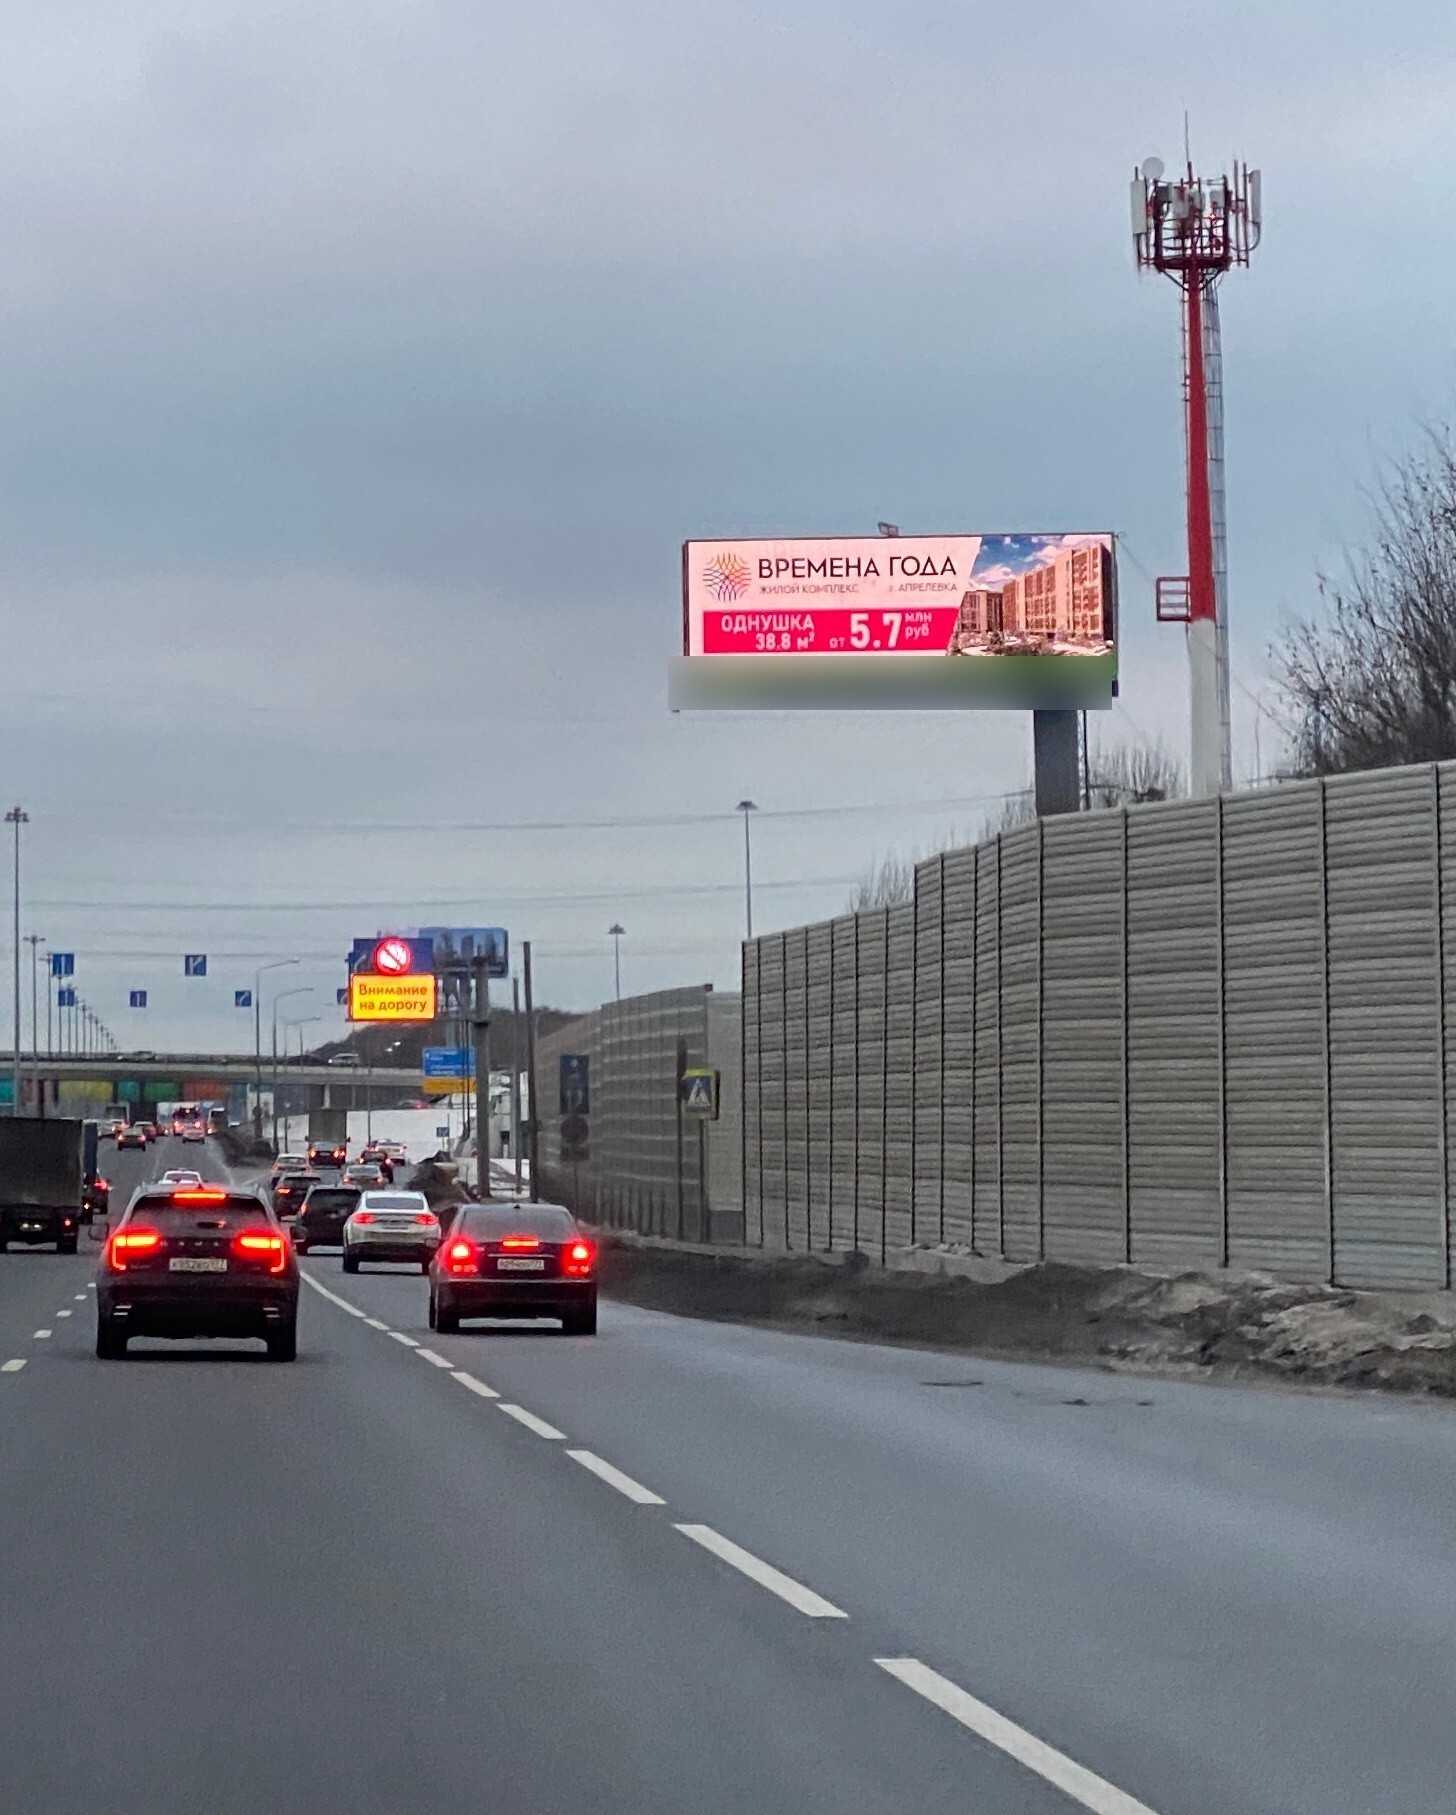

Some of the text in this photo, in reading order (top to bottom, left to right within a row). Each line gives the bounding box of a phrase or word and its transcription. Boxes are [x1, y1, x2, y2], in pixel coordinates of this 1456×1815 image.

[758, 555, 957, 579] ВРЕМЕНА ГОДА
[760, 583, 859, 594] ЖИЛОЙ КОМПЛЕКС
[898, 582, 958, 593] АПРЕЛЕВКА
[721, 614, 815, 634] ОДНУШКА
[829, 612, 902, 649] от 5.7
[905, 622, 929, 640] руб
[755, 632, 791, 650] 38.8
[359, 984, 428, 996] Внимание
[359, 1001, 427, 1012] на дорогу
